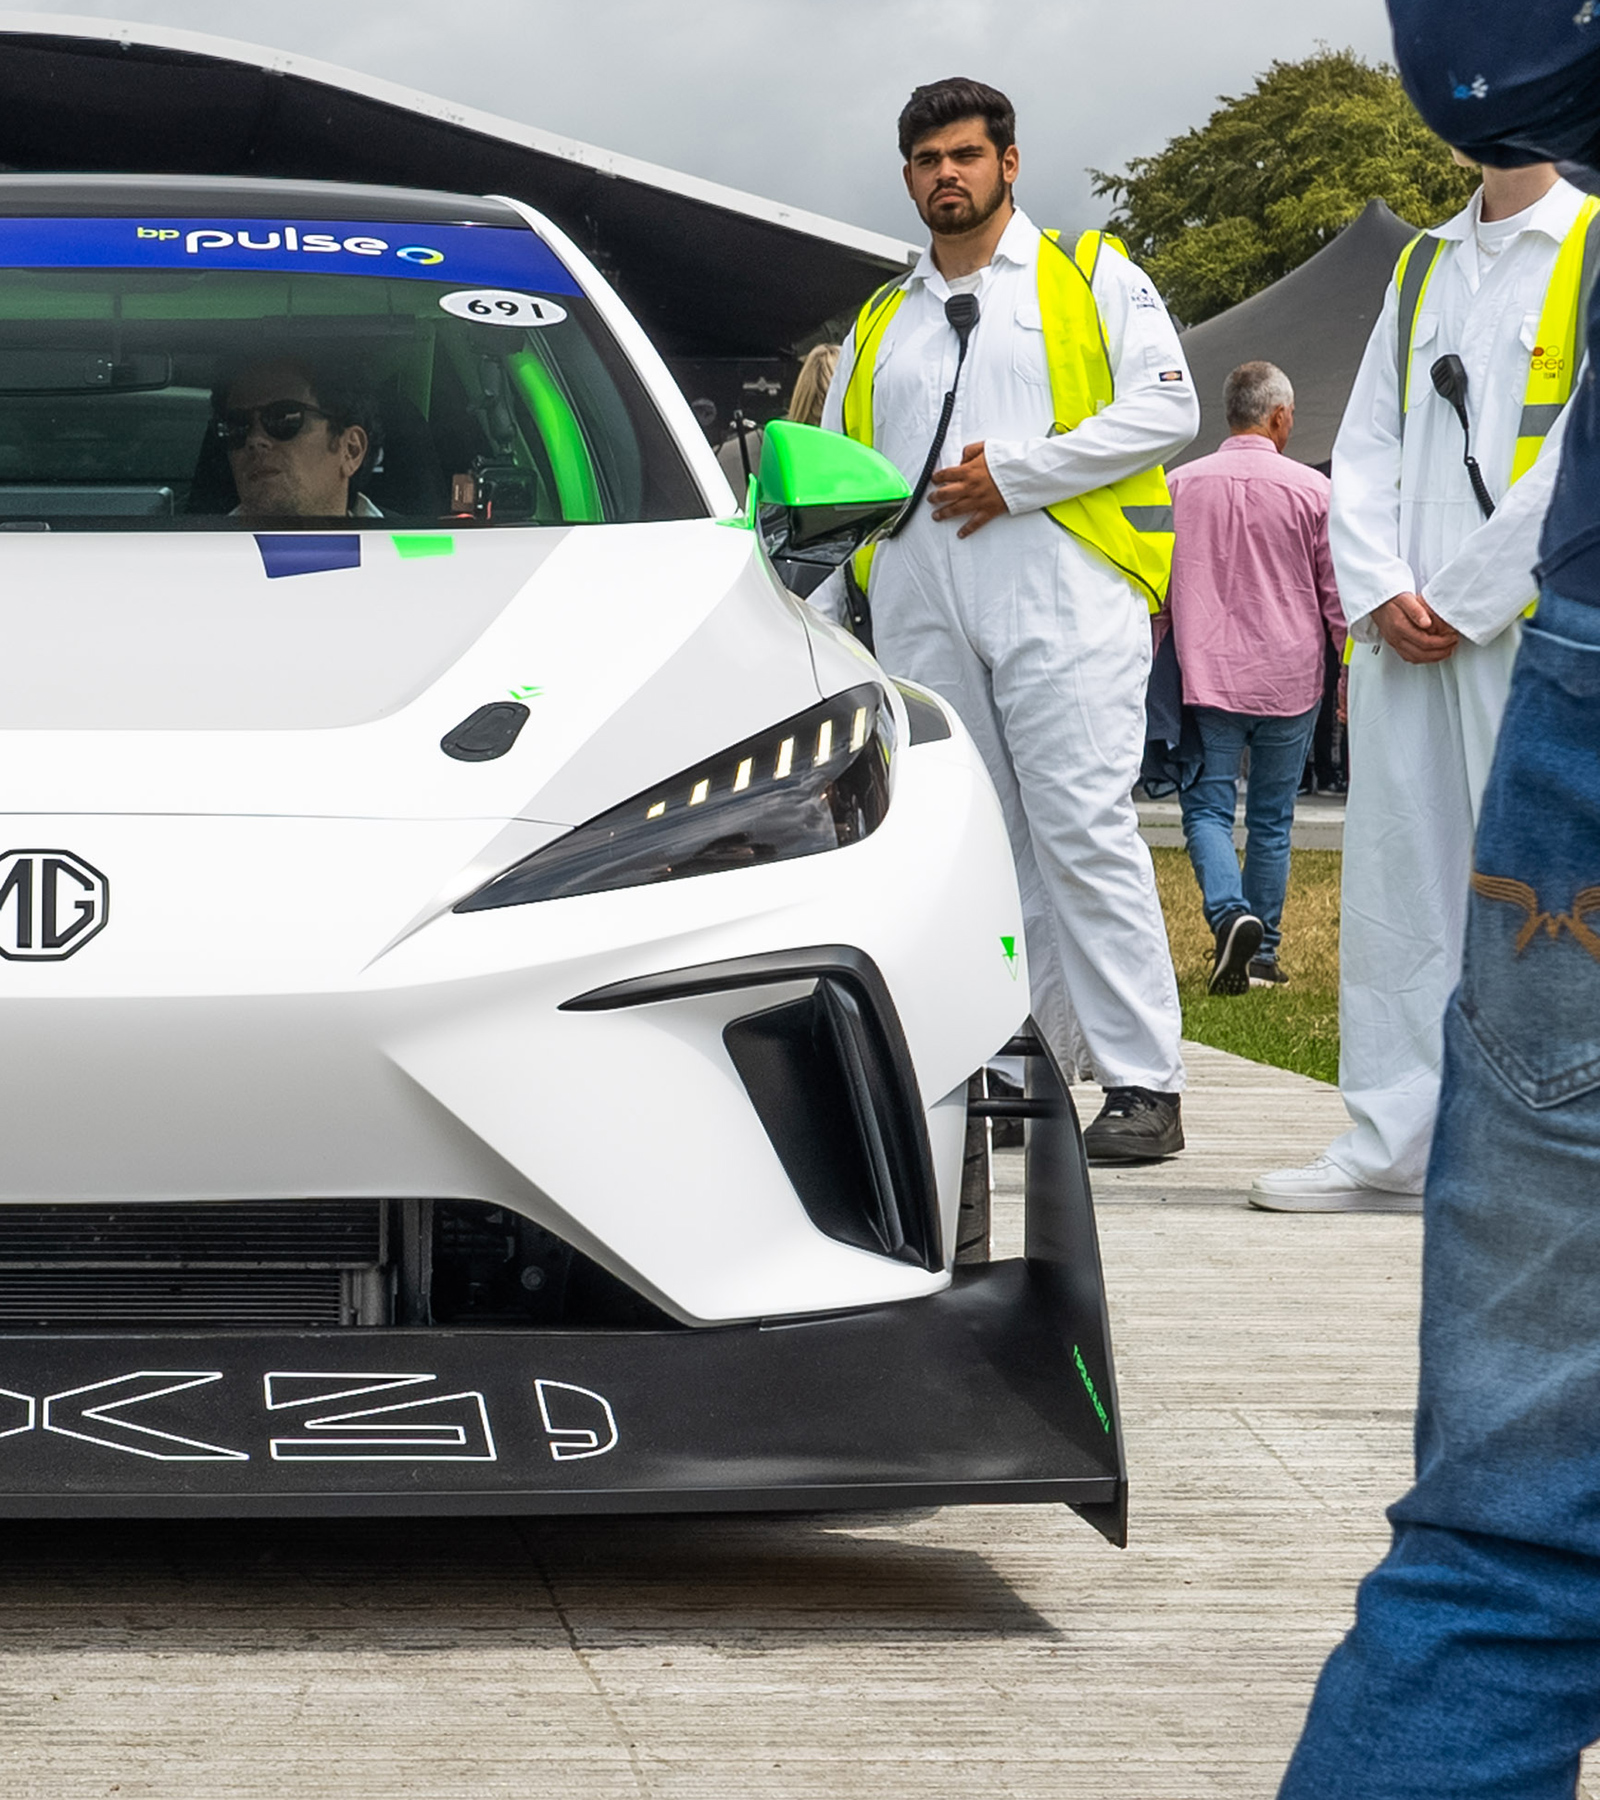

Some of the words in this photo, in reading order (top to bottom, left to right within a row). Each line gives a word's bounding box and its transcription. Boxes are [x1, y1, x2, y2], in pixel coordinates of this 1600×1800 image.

[136, 226, 181, 241] bp
[185, 226, 389, 256] pulse
[468, 299, 545, 319] 691
